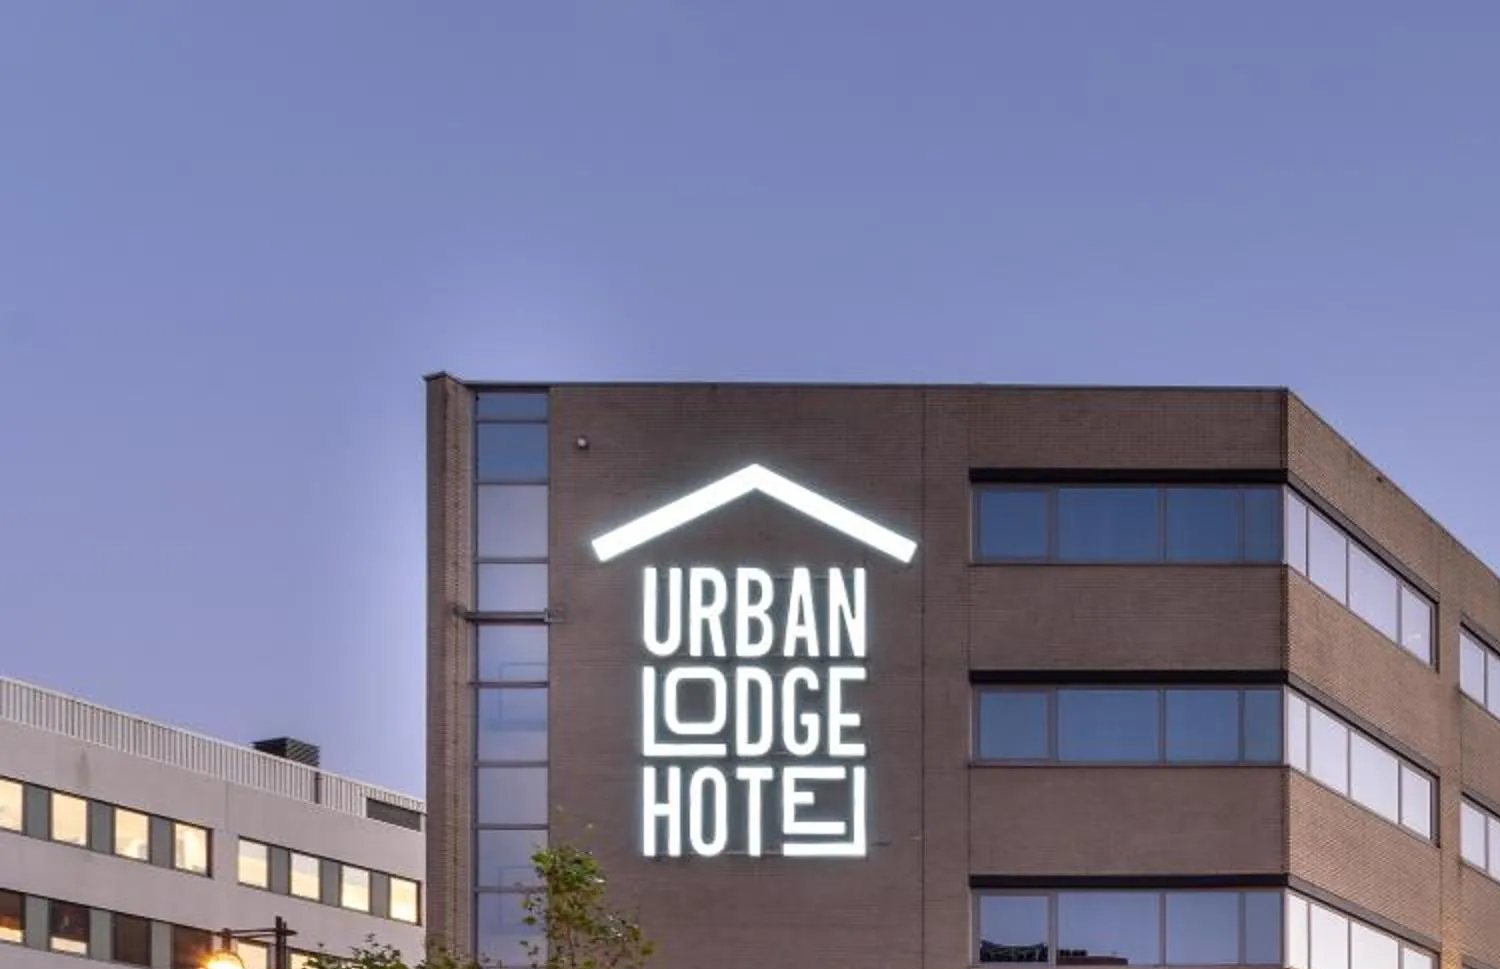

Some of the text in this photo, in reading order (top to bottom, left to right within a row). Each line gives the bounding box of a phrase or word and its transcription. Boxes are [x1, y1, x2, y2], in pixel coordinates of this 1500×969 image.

[643, 567, 866, 657] URBAN
[643, 666, 866, 756] LODGE
[643, 766, 866, 857] HOTEL
